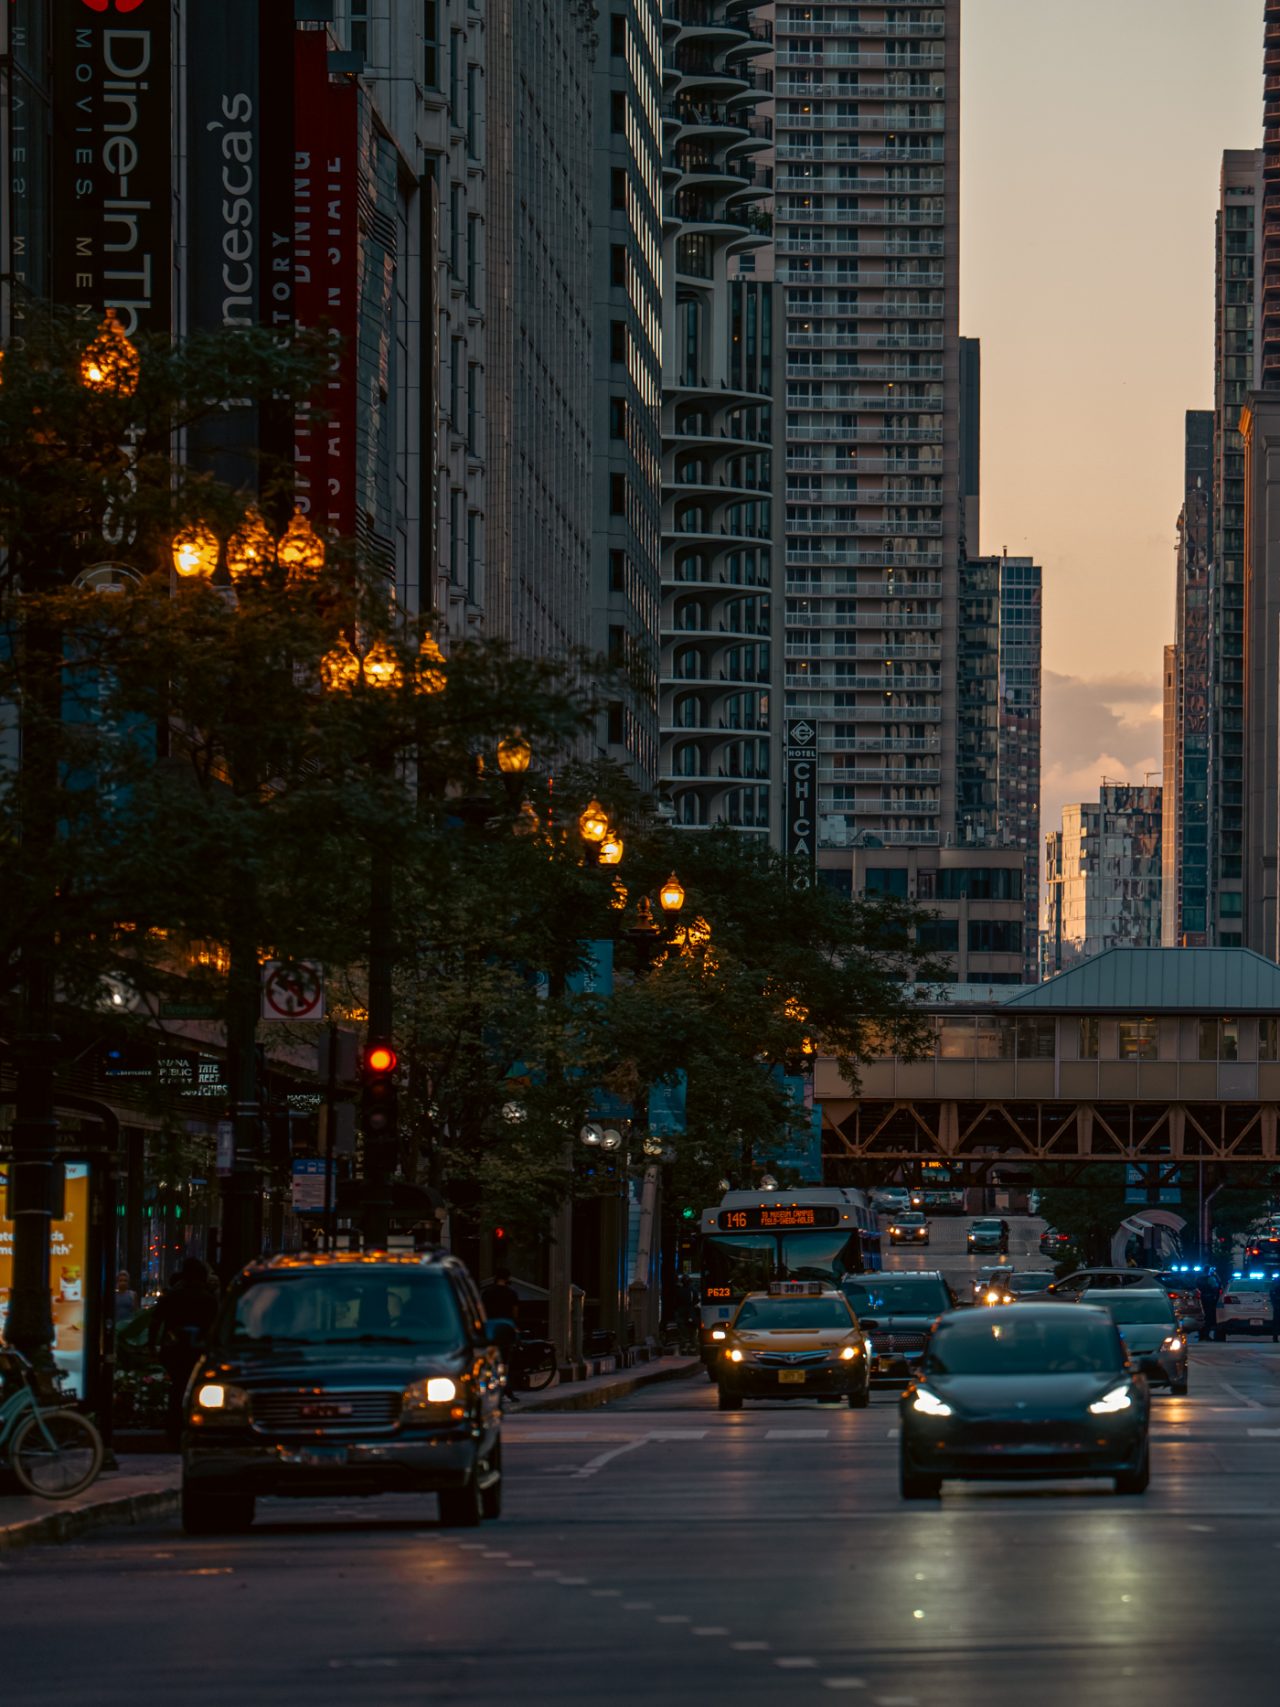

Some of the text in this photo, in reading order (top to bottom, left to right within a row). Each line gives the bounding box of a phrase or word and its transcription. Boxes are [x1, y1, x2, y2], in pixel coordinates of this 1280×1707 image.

[272, 231, 291, 401] FCTORY
[793, 762, 811, 855] CHICA
[727, 1212, 747, 1228] 146
